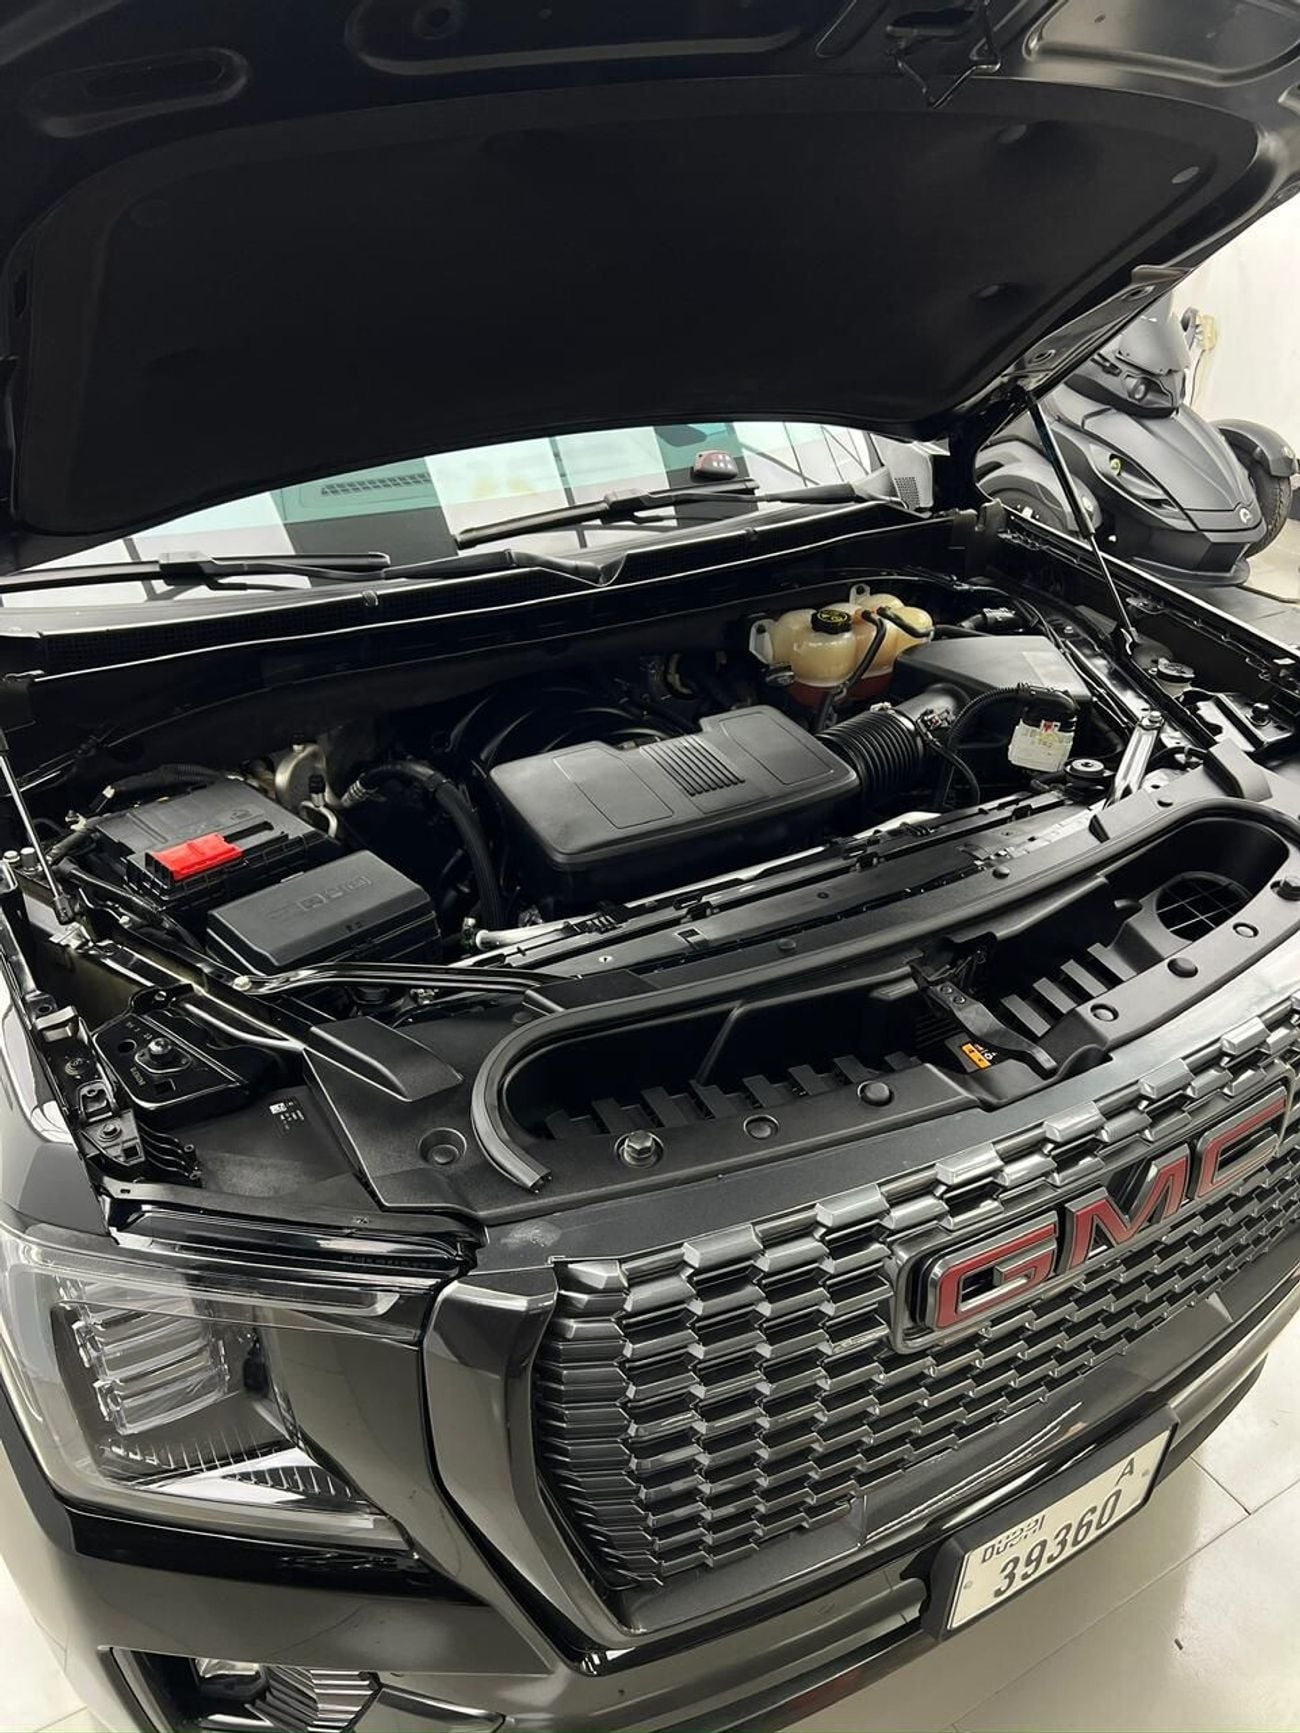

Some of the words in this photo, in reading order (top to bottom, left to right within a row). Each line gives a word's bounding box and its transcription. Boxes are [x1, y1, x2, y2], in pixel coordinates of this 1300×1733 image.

[927, 1085, 1287, 1329] GMC
[1115, 1457, 1135, 1486] A
[993, 1488, 1122, 1598] 39360
